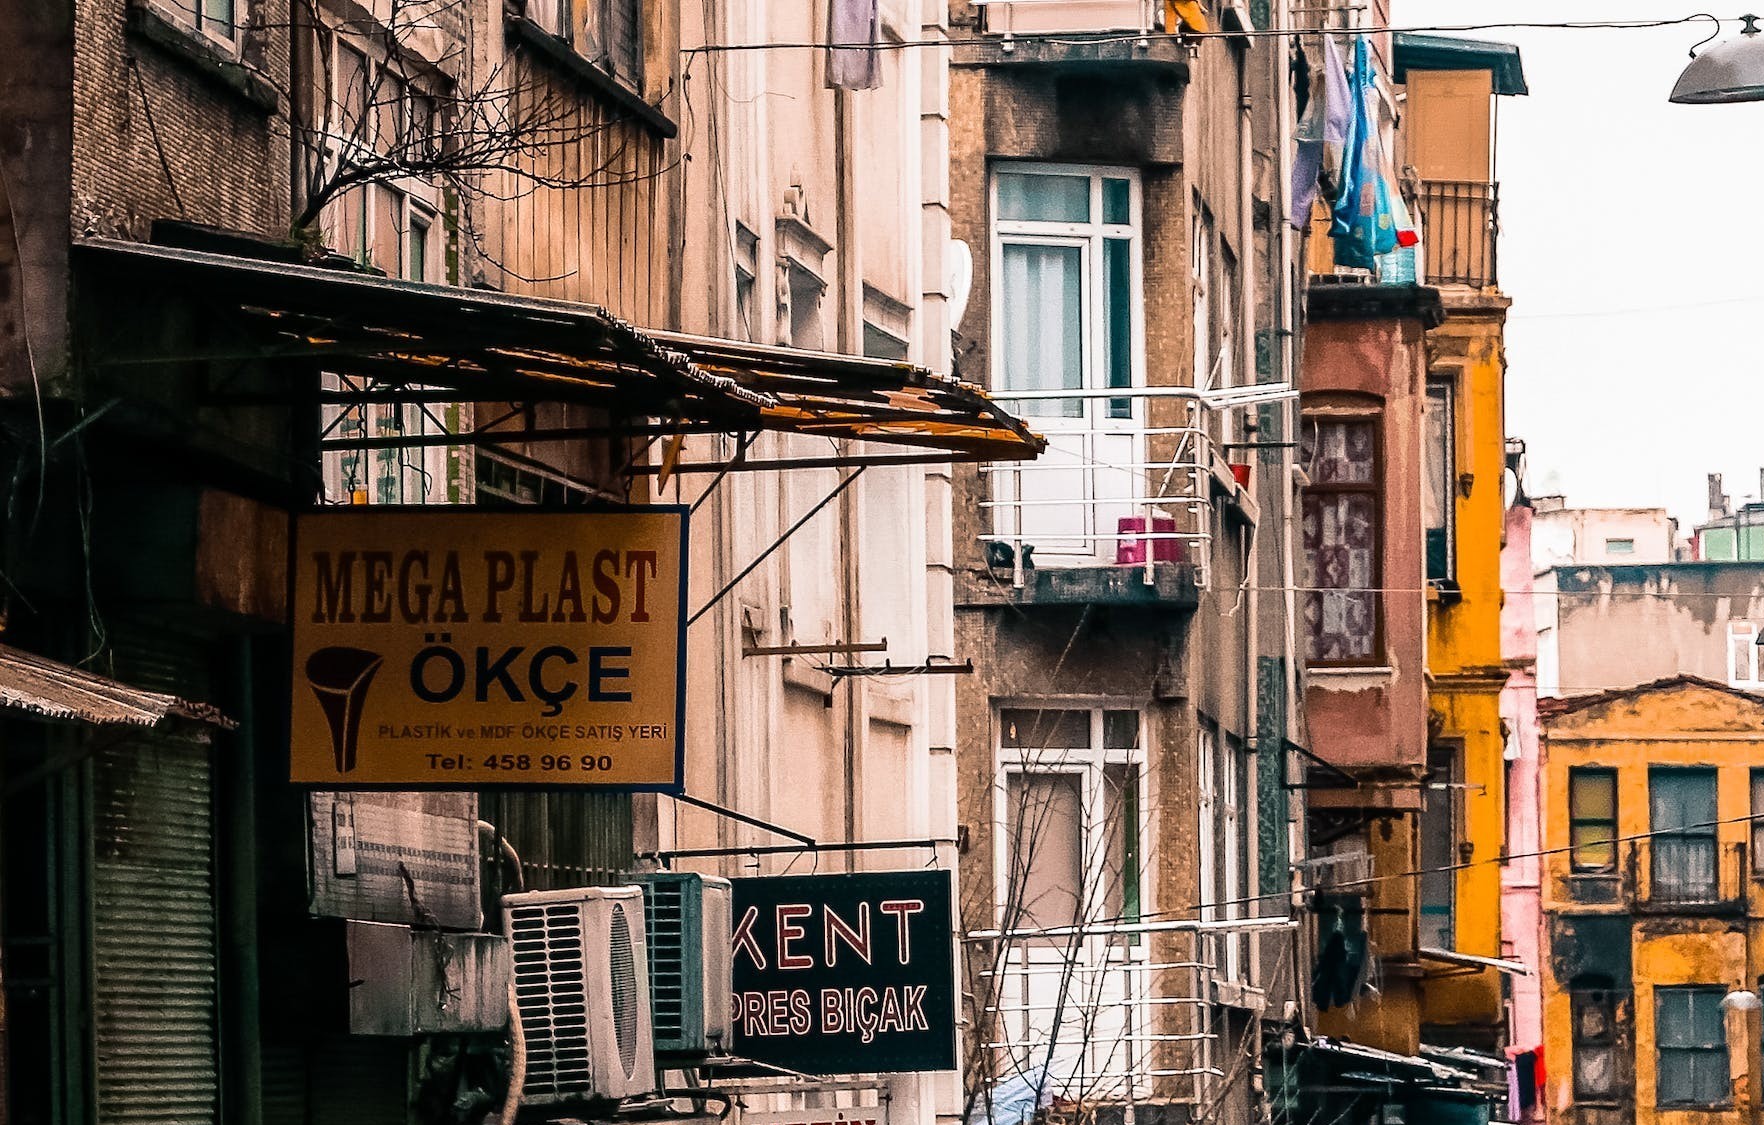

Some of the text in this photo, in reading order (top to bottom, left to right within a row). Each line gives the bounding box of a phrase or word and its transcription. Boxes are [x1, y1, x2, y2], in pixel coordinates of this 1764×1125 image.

[311, 549, 658, 625] MEGA PLAST
[409, 632, 633, 718] ÖKÇE
[378, 722, 668, 742] PLASTİK ve MDF ÖKÇE SATIŞ YERİ
[425, 753, 613, 772] Tel: 458 96 90
[732, 899, 925, 971] KENT
[820, 985, 930, 1044] BIÇAK
